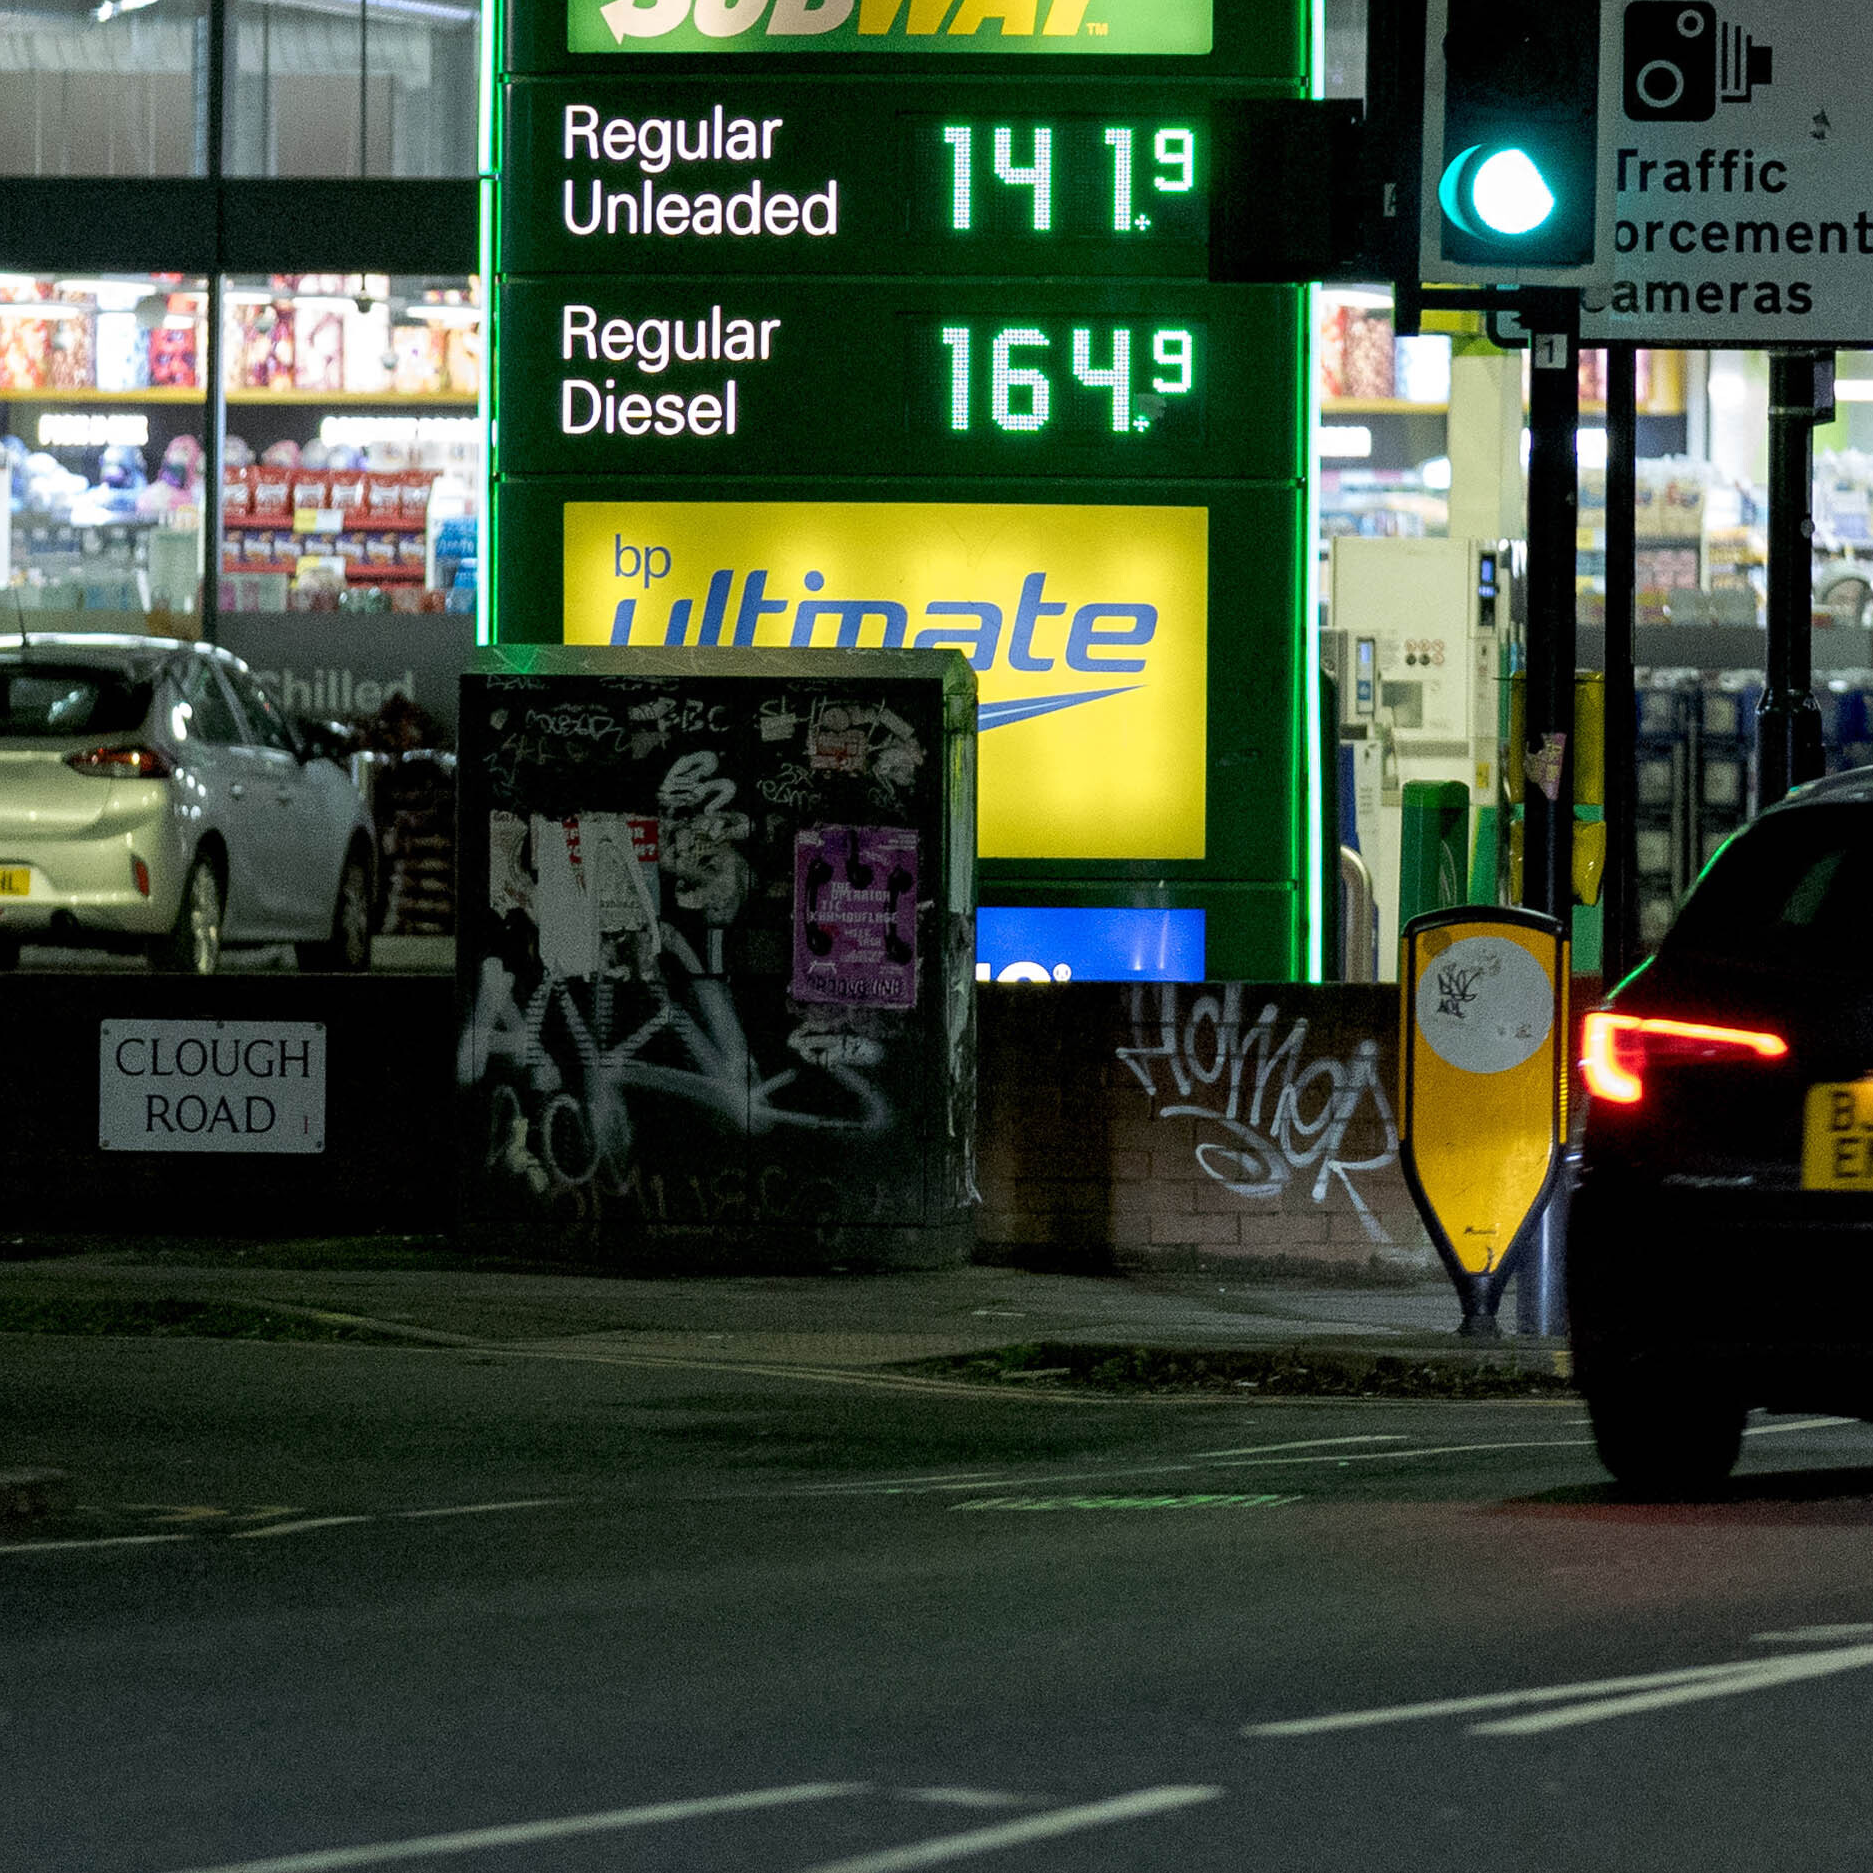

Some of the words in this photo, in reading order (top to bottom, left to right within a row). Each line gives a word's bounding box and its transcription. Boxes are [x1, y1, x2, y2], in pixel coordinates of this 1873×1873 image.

[562, 104, 783, 172] Regular
[562, 179, 840, 236] Unleaded
[560, 304, 782, 373] Regular
[1543, 338, 1555, 364] 1
[560, 379, 738, 437] Diesel
[613, 533, 672, 589] bp
[608, 569, 1159, 672] ultimate
[114, 1038, 311, 1079] CLOUGH
[145, 1095, 276, 1135] ROAD
